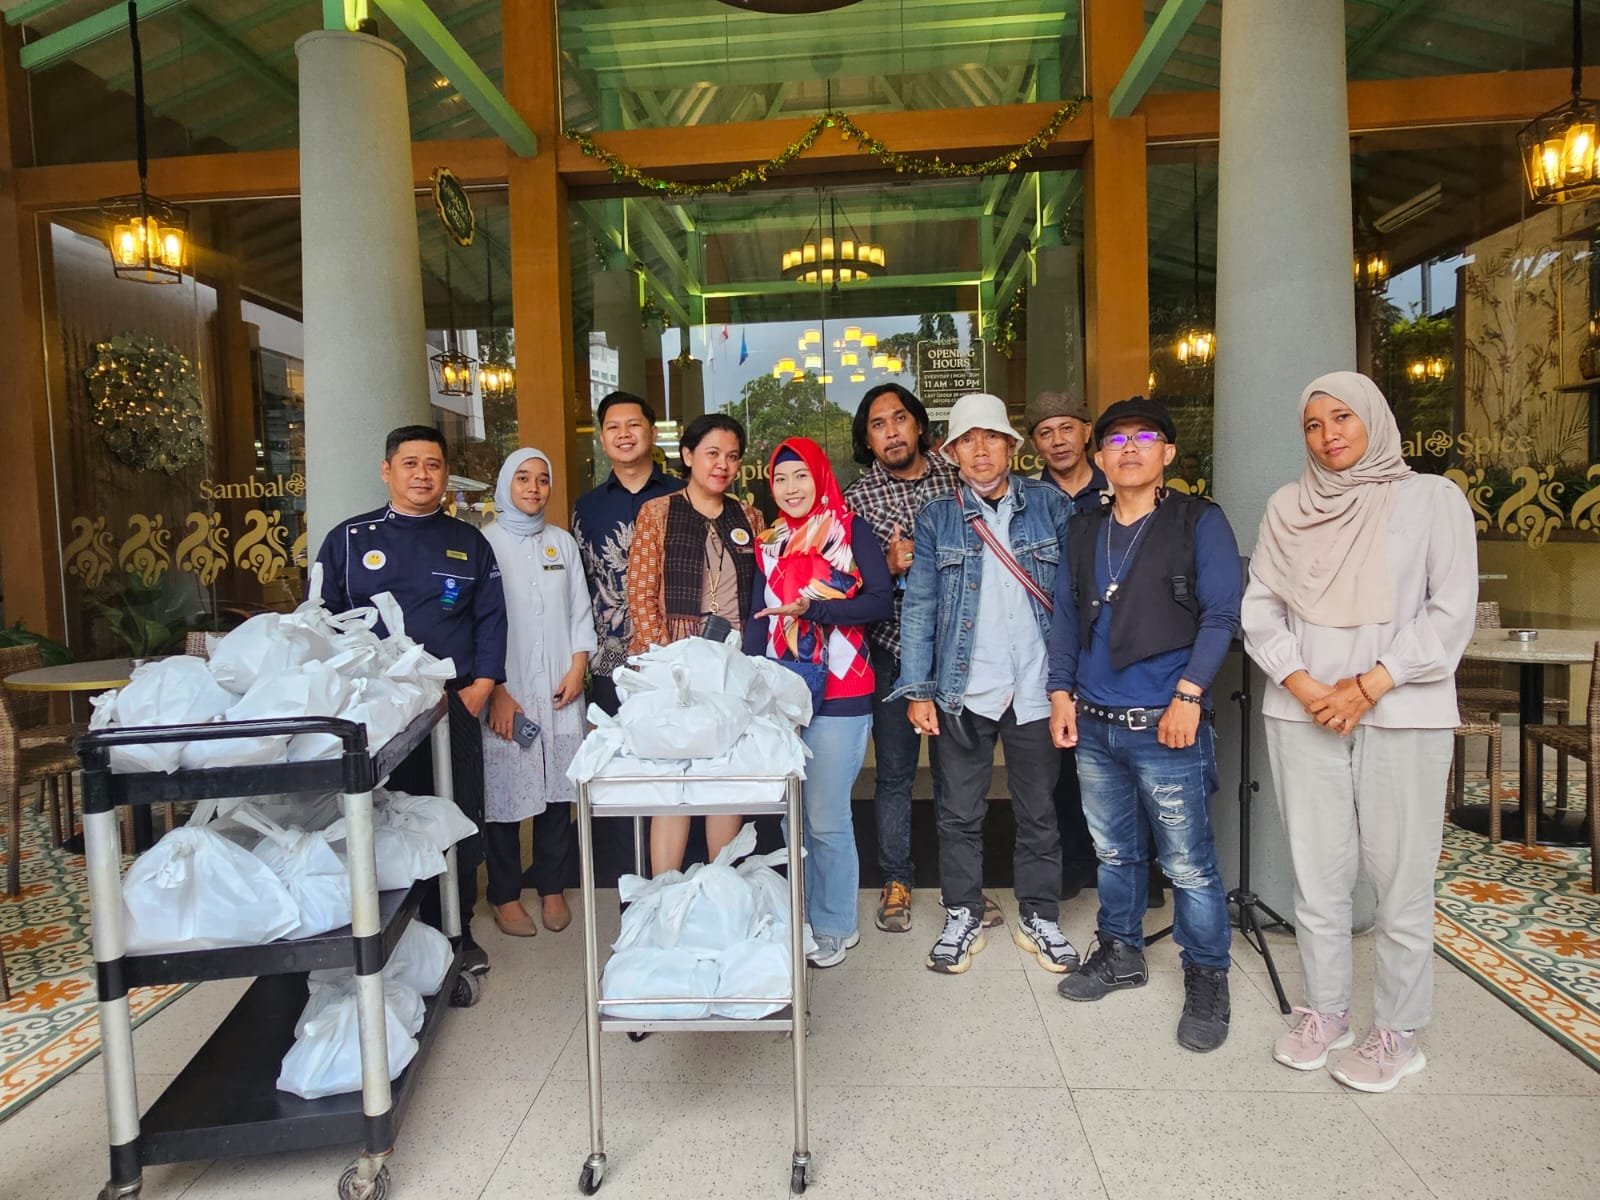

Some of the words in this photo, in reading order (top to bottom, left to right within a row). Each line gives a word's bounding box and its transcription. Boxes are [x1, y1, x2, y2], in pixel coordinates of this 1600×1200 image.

[933, 359, 970, 368] HOURS
[934, 380, 948, 388] AM
[954, 379, 965, 387] 10
[966, 379, 980, 388] PM
[1457, 432, 1533, 462] Spice
[200, 474, 284, 499] Sambal
